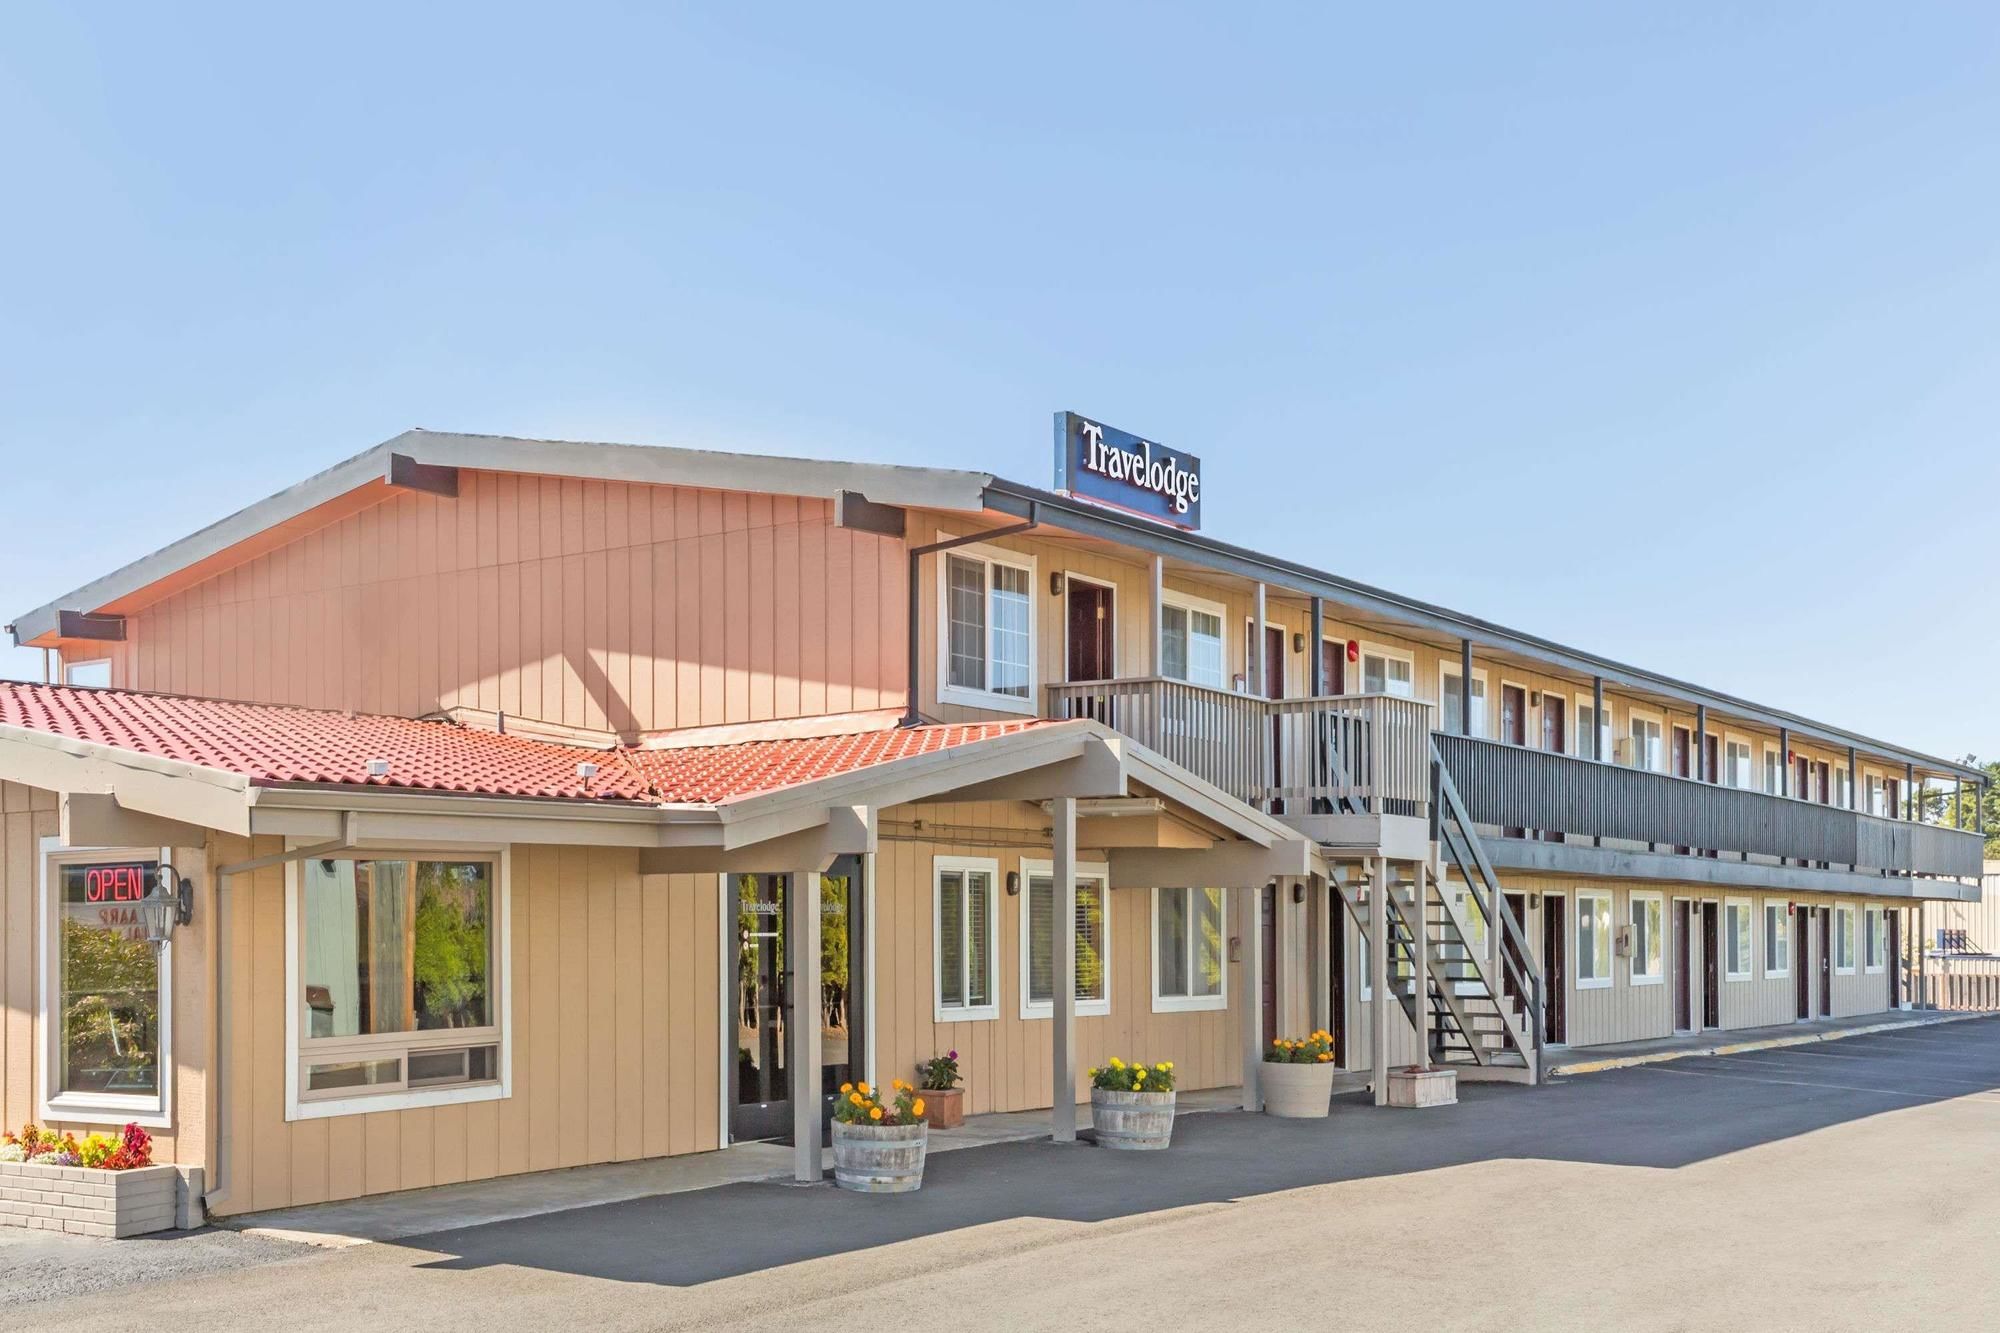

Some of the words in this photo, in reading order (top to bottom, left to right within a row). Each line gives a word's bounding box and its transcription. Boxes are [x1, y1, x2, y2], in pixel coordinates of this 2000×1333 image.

[1082, 421, 1199, 514] Travelodge
[87, 867, 142, 901] OPEN
[740, 899, 780, 916] Travelodge
